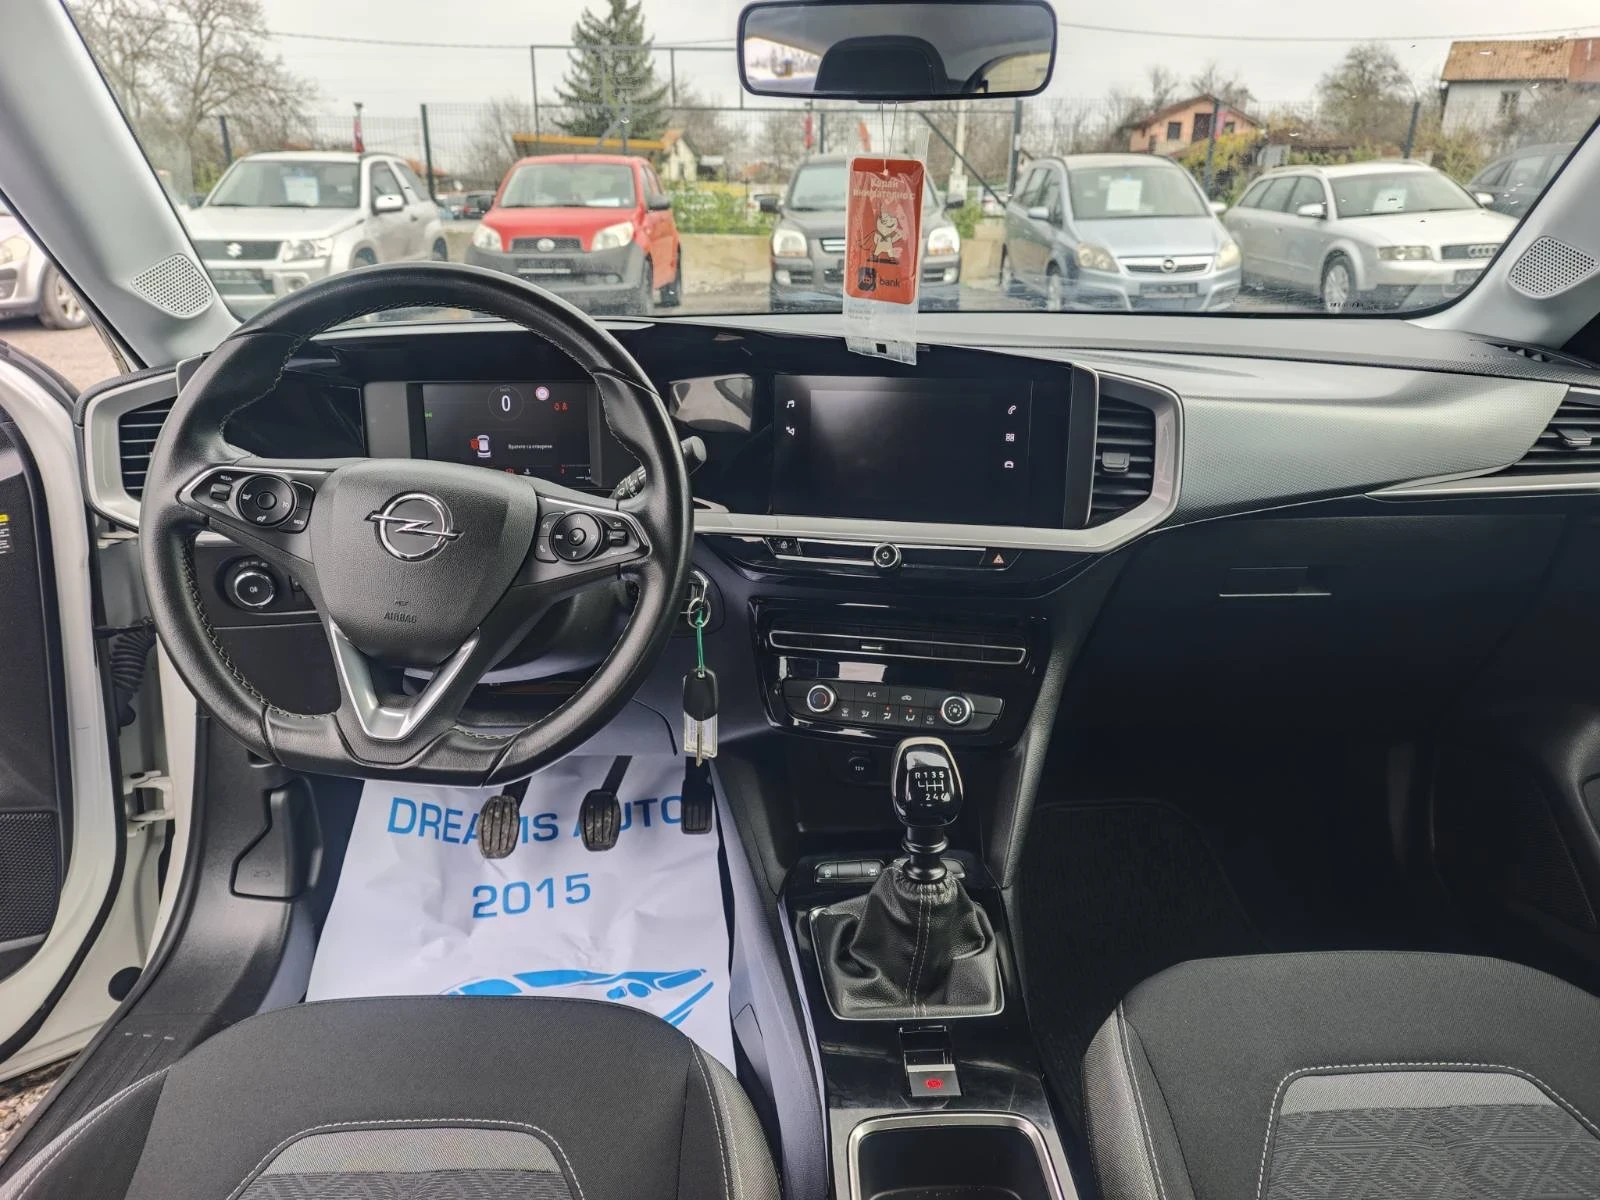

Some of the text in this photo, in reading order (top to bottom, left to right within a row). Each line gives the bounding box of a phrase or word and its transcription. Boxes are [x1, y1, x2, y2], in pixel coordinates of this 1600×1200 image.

[879, 277, 901, 288] bank
[501, 395, 510, 411] 0
[384, 611, 417, 623] AIRBAG
[387, 795, 683, 846] DRES UTO
[471, 872, 592, 919] 2015
